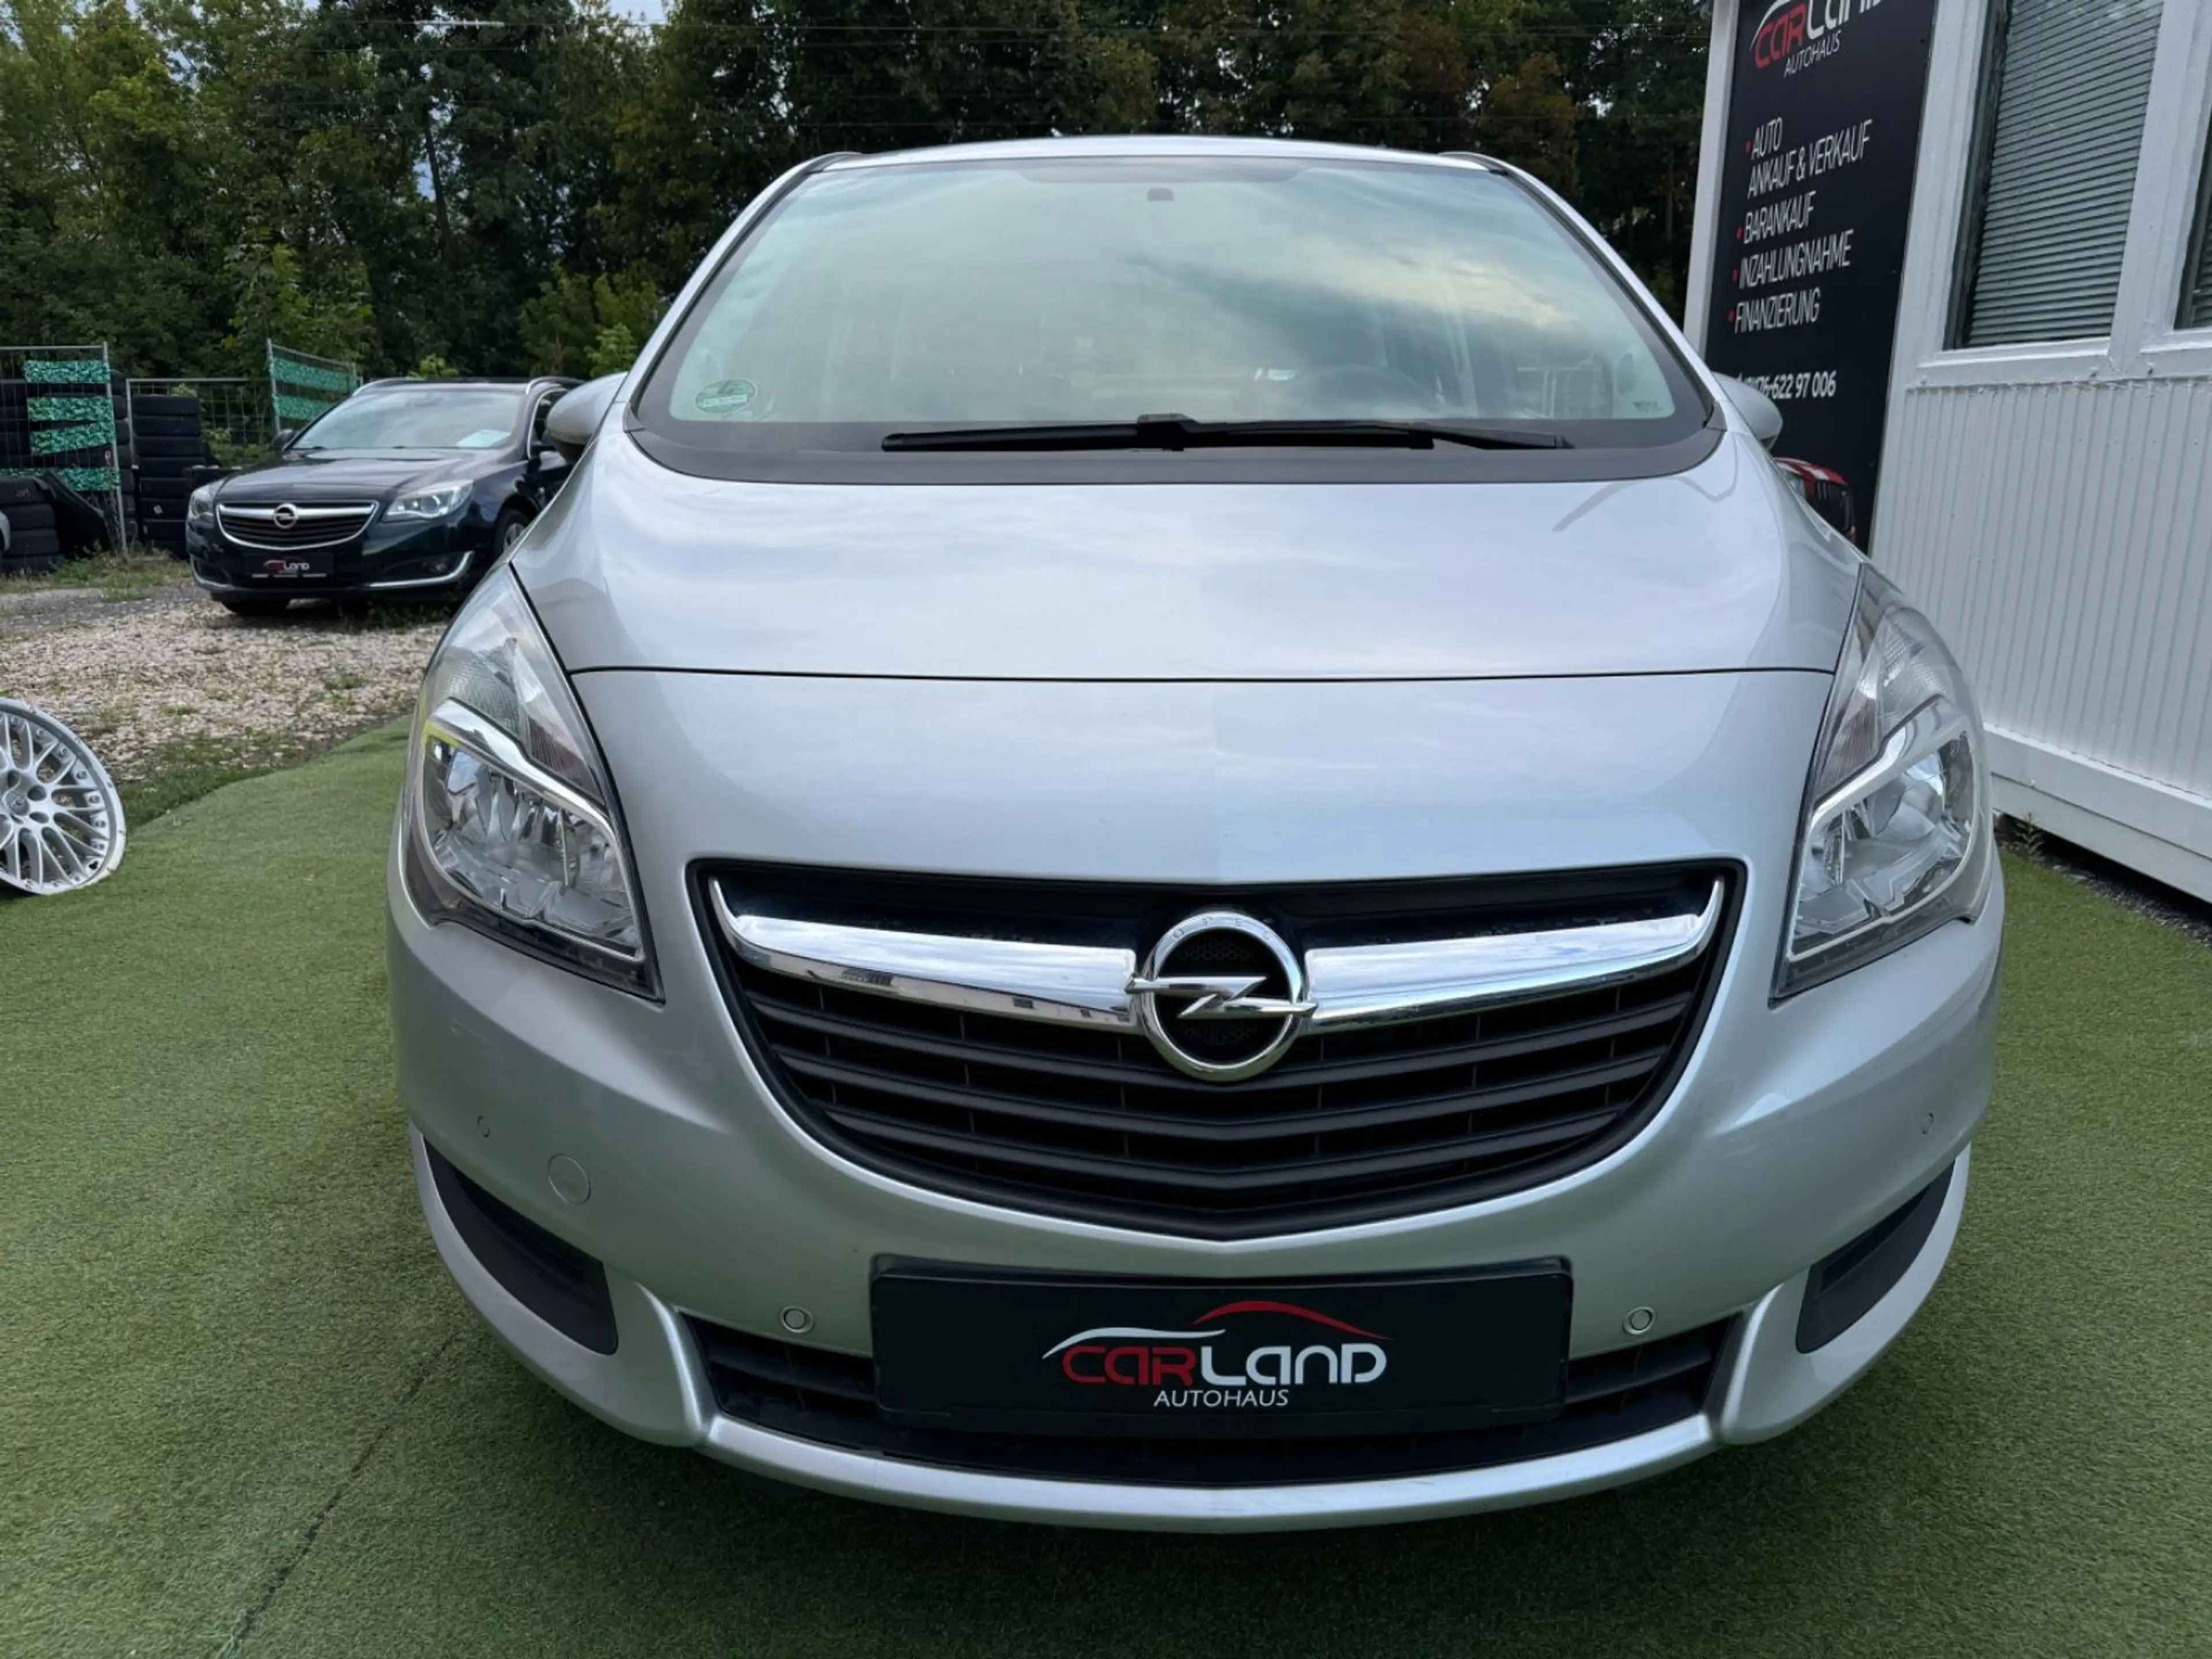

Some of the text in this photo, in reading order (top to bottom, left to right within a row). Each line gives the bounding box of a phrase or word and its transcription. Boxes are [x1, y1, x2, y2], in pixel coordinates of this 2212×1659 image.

[1755, 0, 1881, 68] CARLA
[1783, 30, 1842, 78] AUTOHAUS
[1747, 119, 1872, 199] ANKAUF & VERKAUF
[1751, 116, 1783, 161] AUTO
[1744, 190, 1816, 244] BARANKAUF
[1739, 229, 1854, 289] INZAHLUNGNAHME
[1735, 287, 1821, 334] FINANZIERUNG
[1795, 372, 1811, 399] 97
[1812, 370, 1836, 399] 006
[1172, 916, 1270, 941] OPEL
[1153, 1389, 1289, 1407] AUTOHAUS
